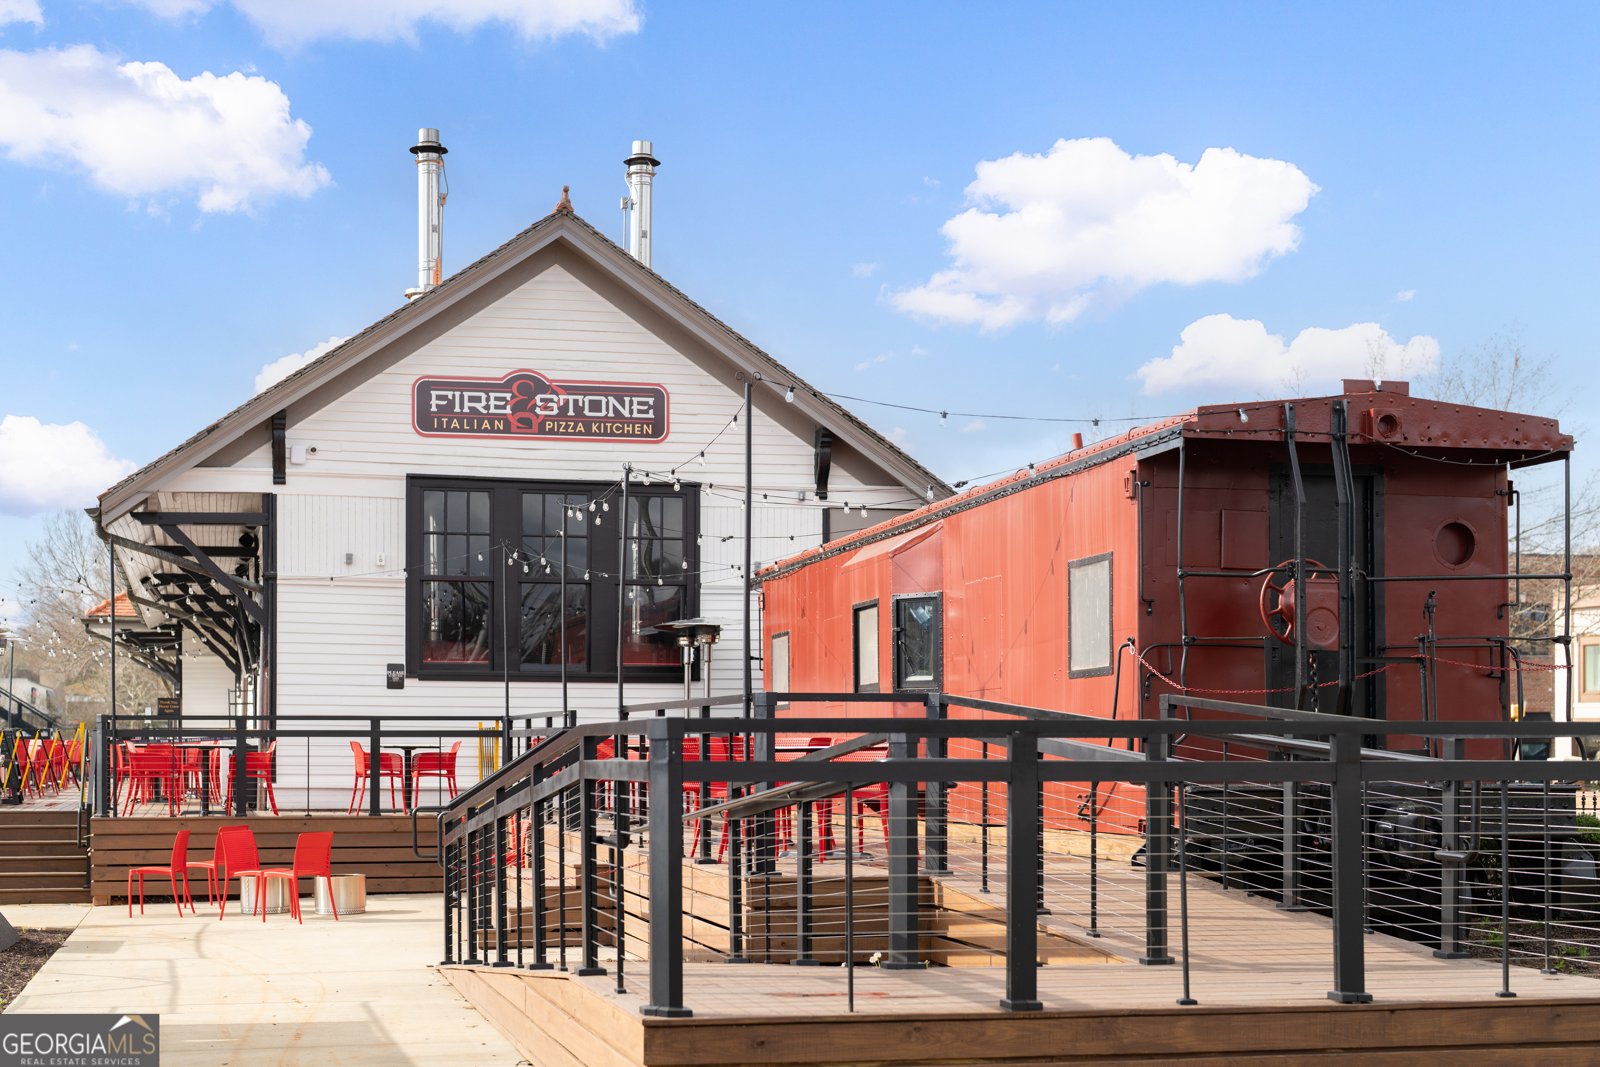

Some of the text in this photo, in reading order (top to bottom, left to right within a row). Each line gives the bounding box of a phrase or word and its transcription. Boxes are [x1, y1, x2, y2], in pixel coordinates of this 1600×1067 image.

[430, 390, 512, 414] FIRE
[534, 394, 655, 418] STONE
[434, 417, 504, 431] ITALIAN
[545, 421, 653, 435] PIZZA KITCHEN
